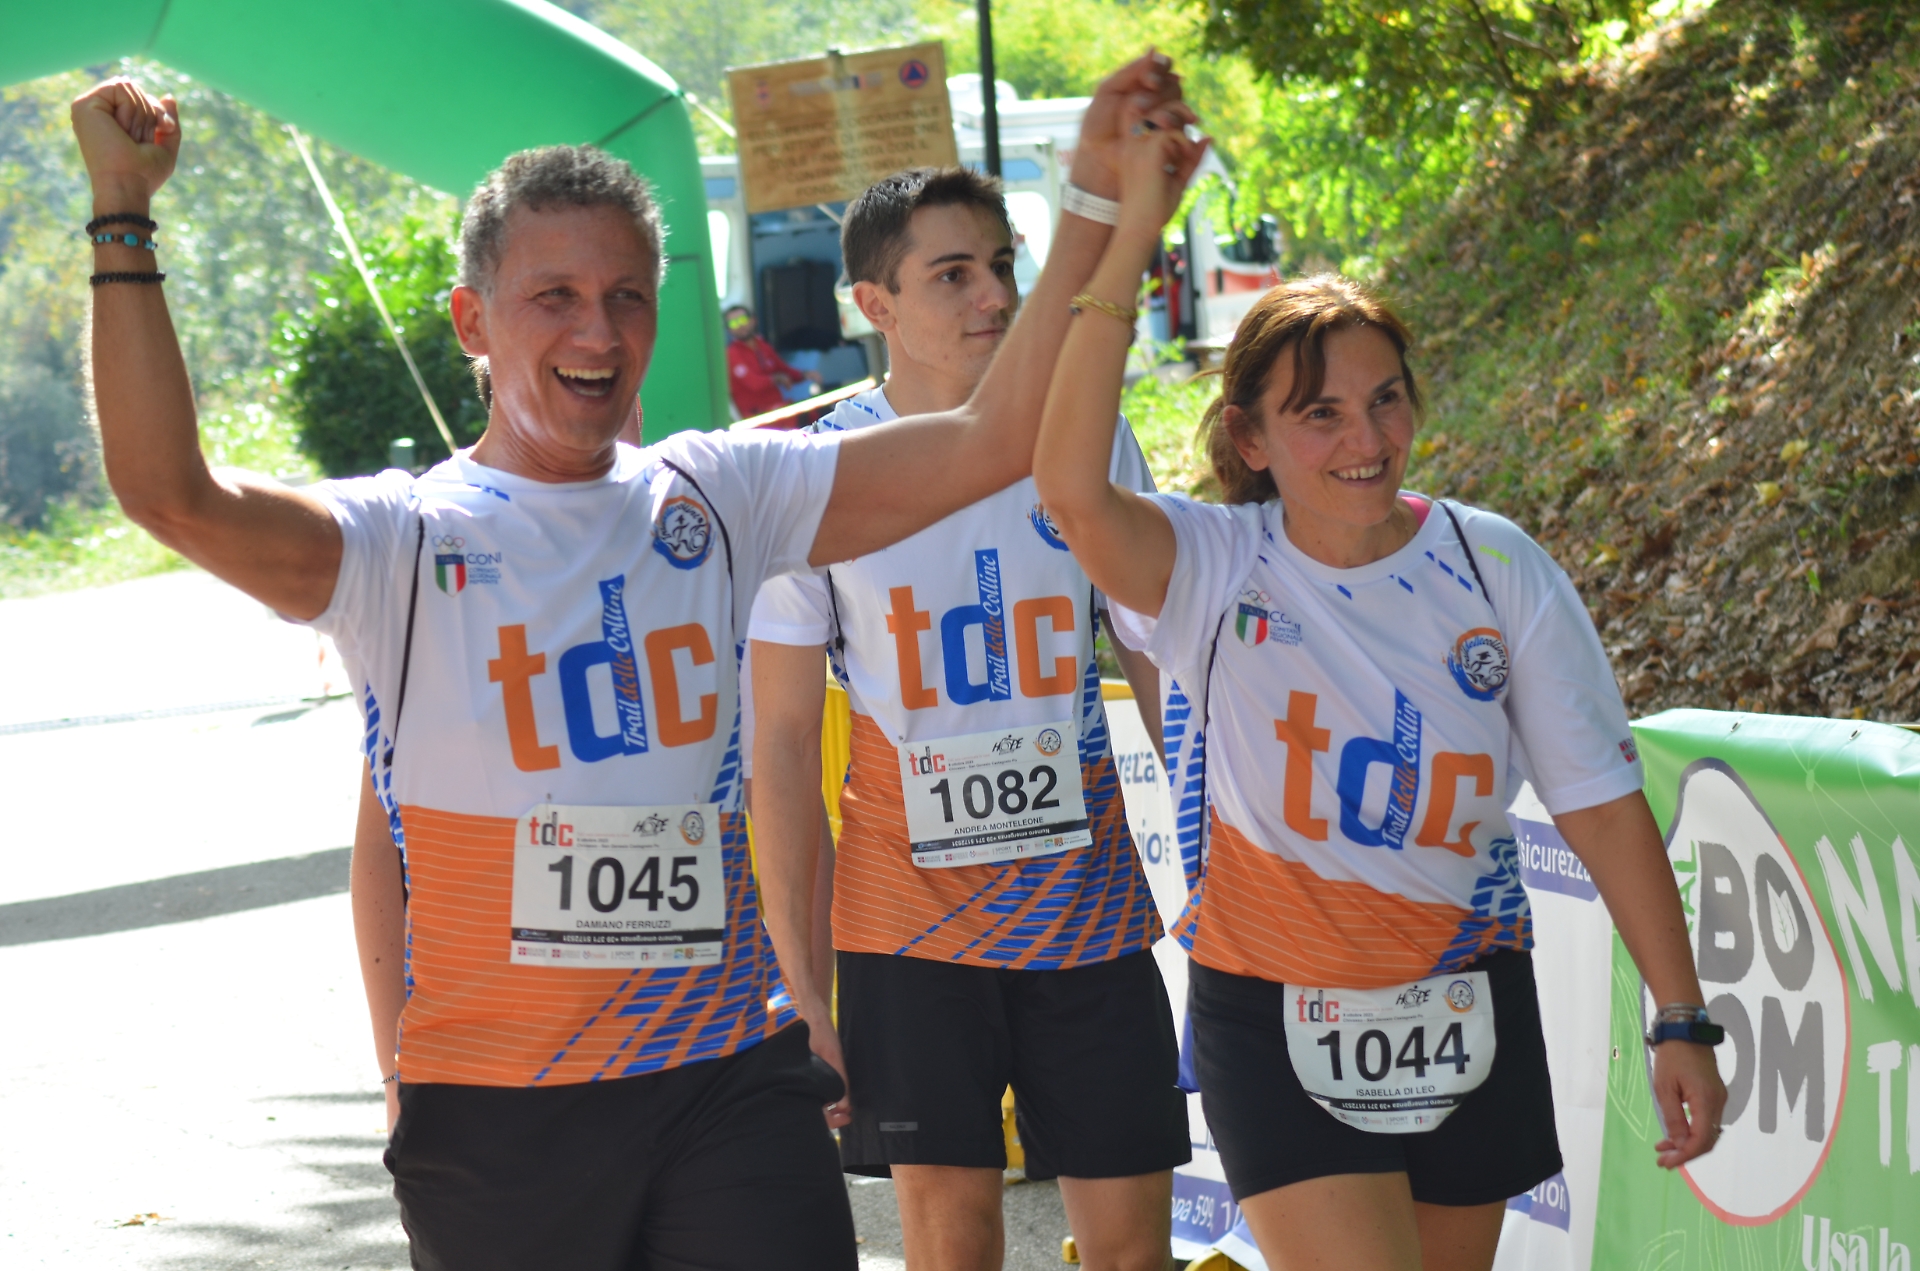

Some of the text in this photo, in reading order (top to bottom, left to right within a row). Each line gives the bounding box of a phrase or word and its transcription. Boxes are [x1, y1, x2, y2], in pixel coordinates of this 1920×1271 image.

[466, 552, 502, 565] CONI
[930, 765, 1060, 823] 1082
[529, 812, 574, 847] tdc
[954, 816, 1044, 835] ANDREA MONTELEONE
[548, 855, 699, 913] 1045
[576, 920, 623, 930] DAMIANO
[626, 919, 671, 930] FERRUZZI
[1317, 1022, 1470, 1082] 1044
[1356, 1085, 1435, 1097] ISABELLA DI LEO
